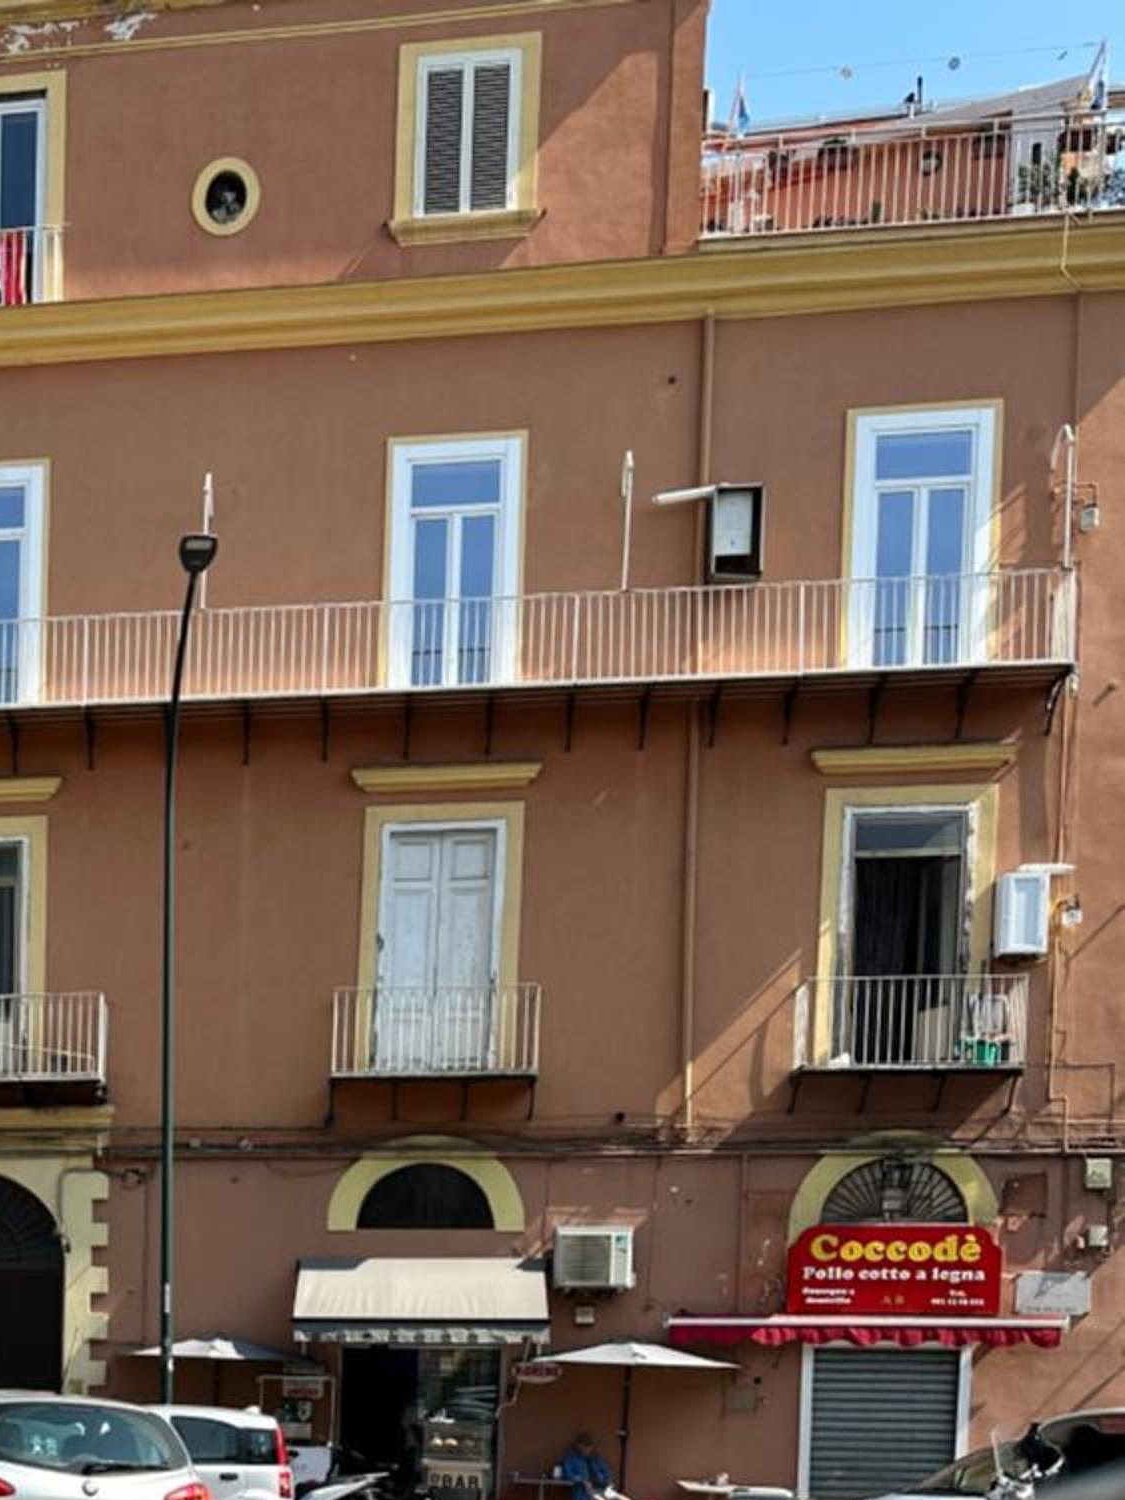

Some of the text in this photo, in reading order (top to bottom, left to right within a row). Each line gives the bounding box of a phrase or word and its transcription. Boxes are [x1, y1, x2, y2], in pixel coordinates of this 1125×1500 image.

[810, 1233, 982, 1262] Coccodè
[802, 1265, 985, 1285] Pollo cotto a legna
